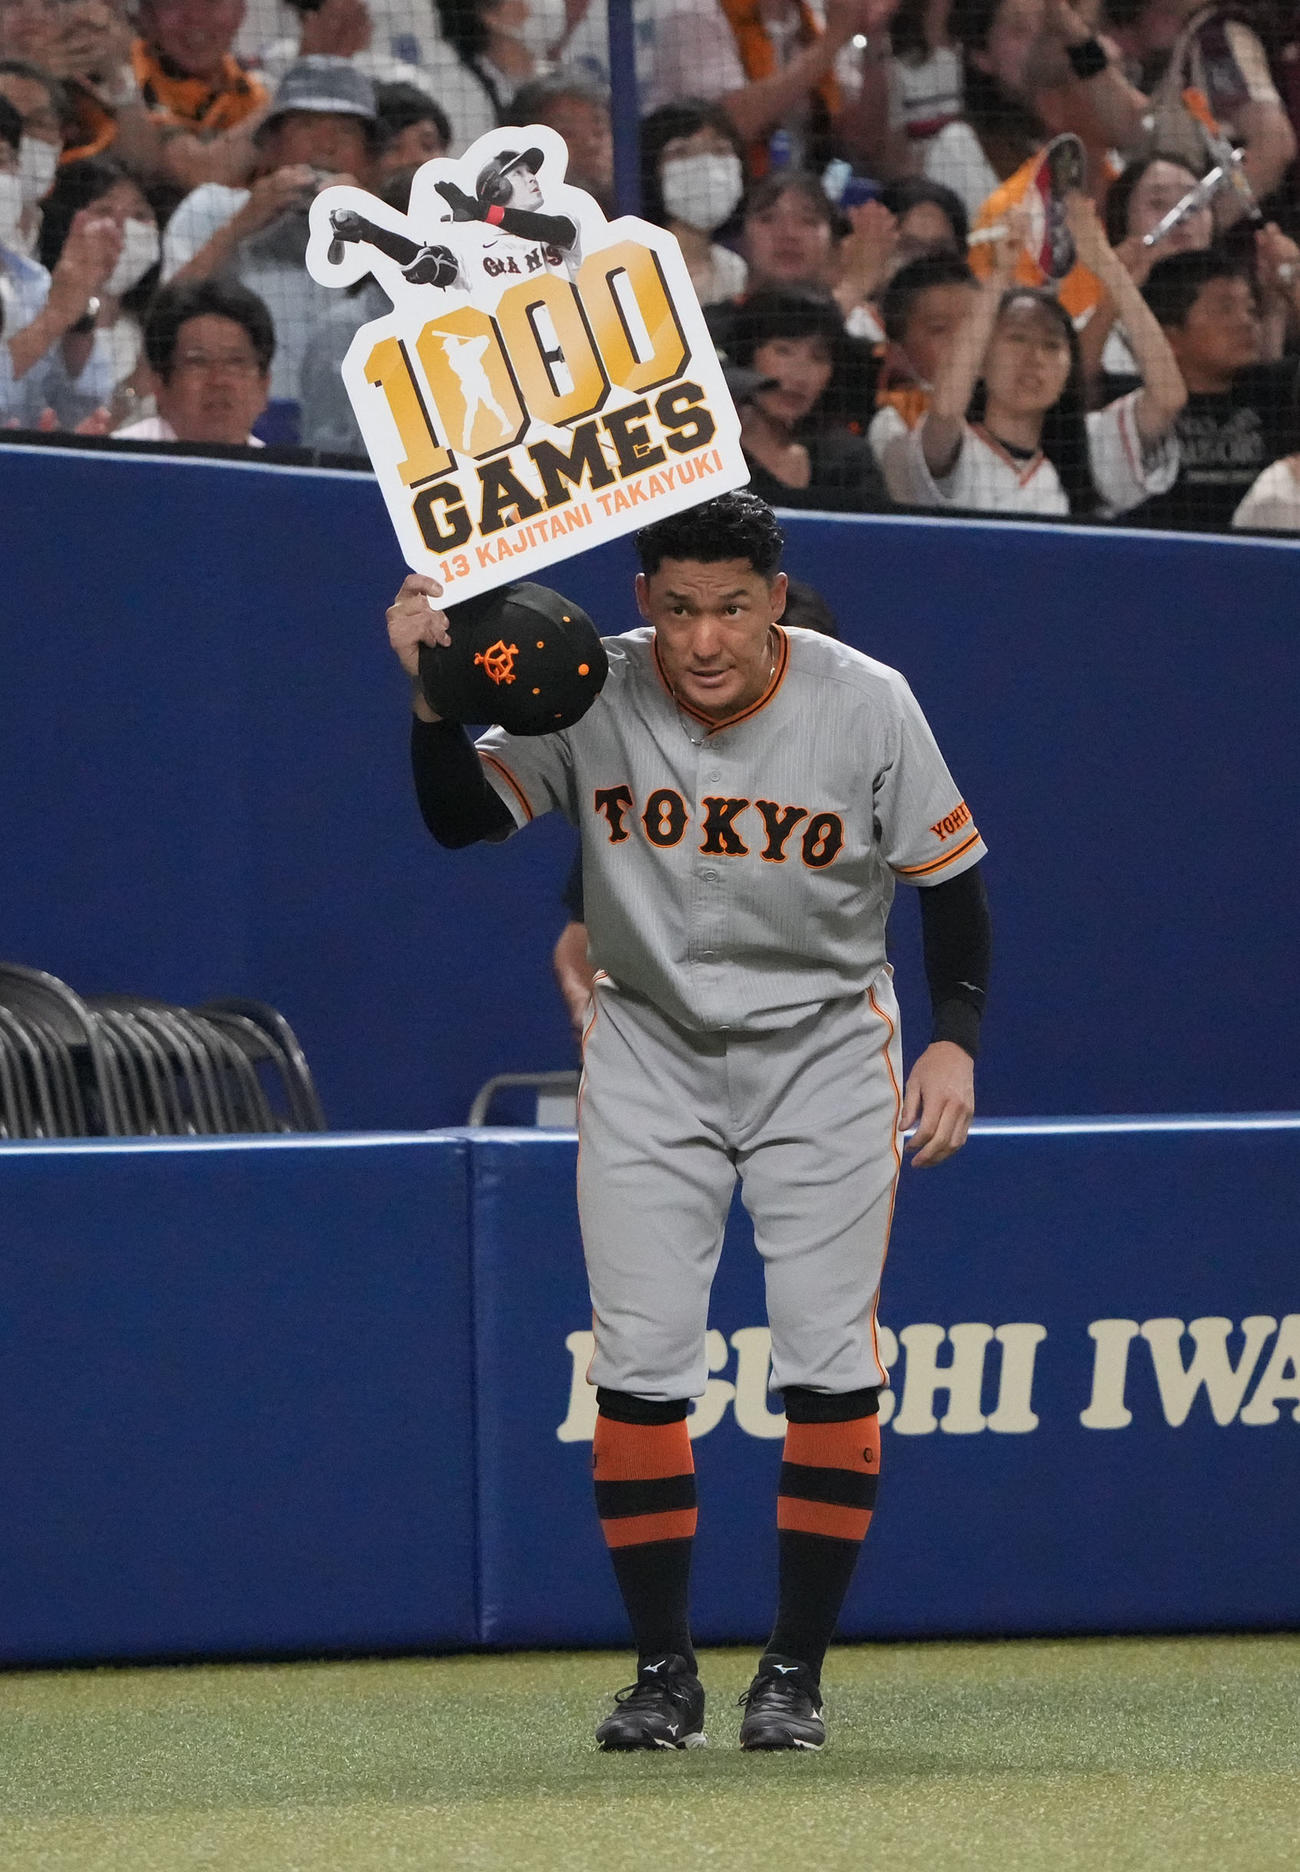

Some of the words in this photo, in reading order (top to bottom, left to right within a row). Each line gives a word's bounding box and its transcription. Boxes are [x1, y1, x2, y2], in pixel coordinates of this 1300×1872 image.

[483, 245, 563, 277] GIANS
[363, 239, 692, 490] 1000
[411, 379, 718, 555] GAMES
[438, 554, 472, 583] 13
[474, 502, 593, 569] KAJITANI
[596, 449, 724, 517] TAKAYUKI
[594, 783, 846, 869] TOKYO
[1079, 1313, 1300, 1430] IWA
